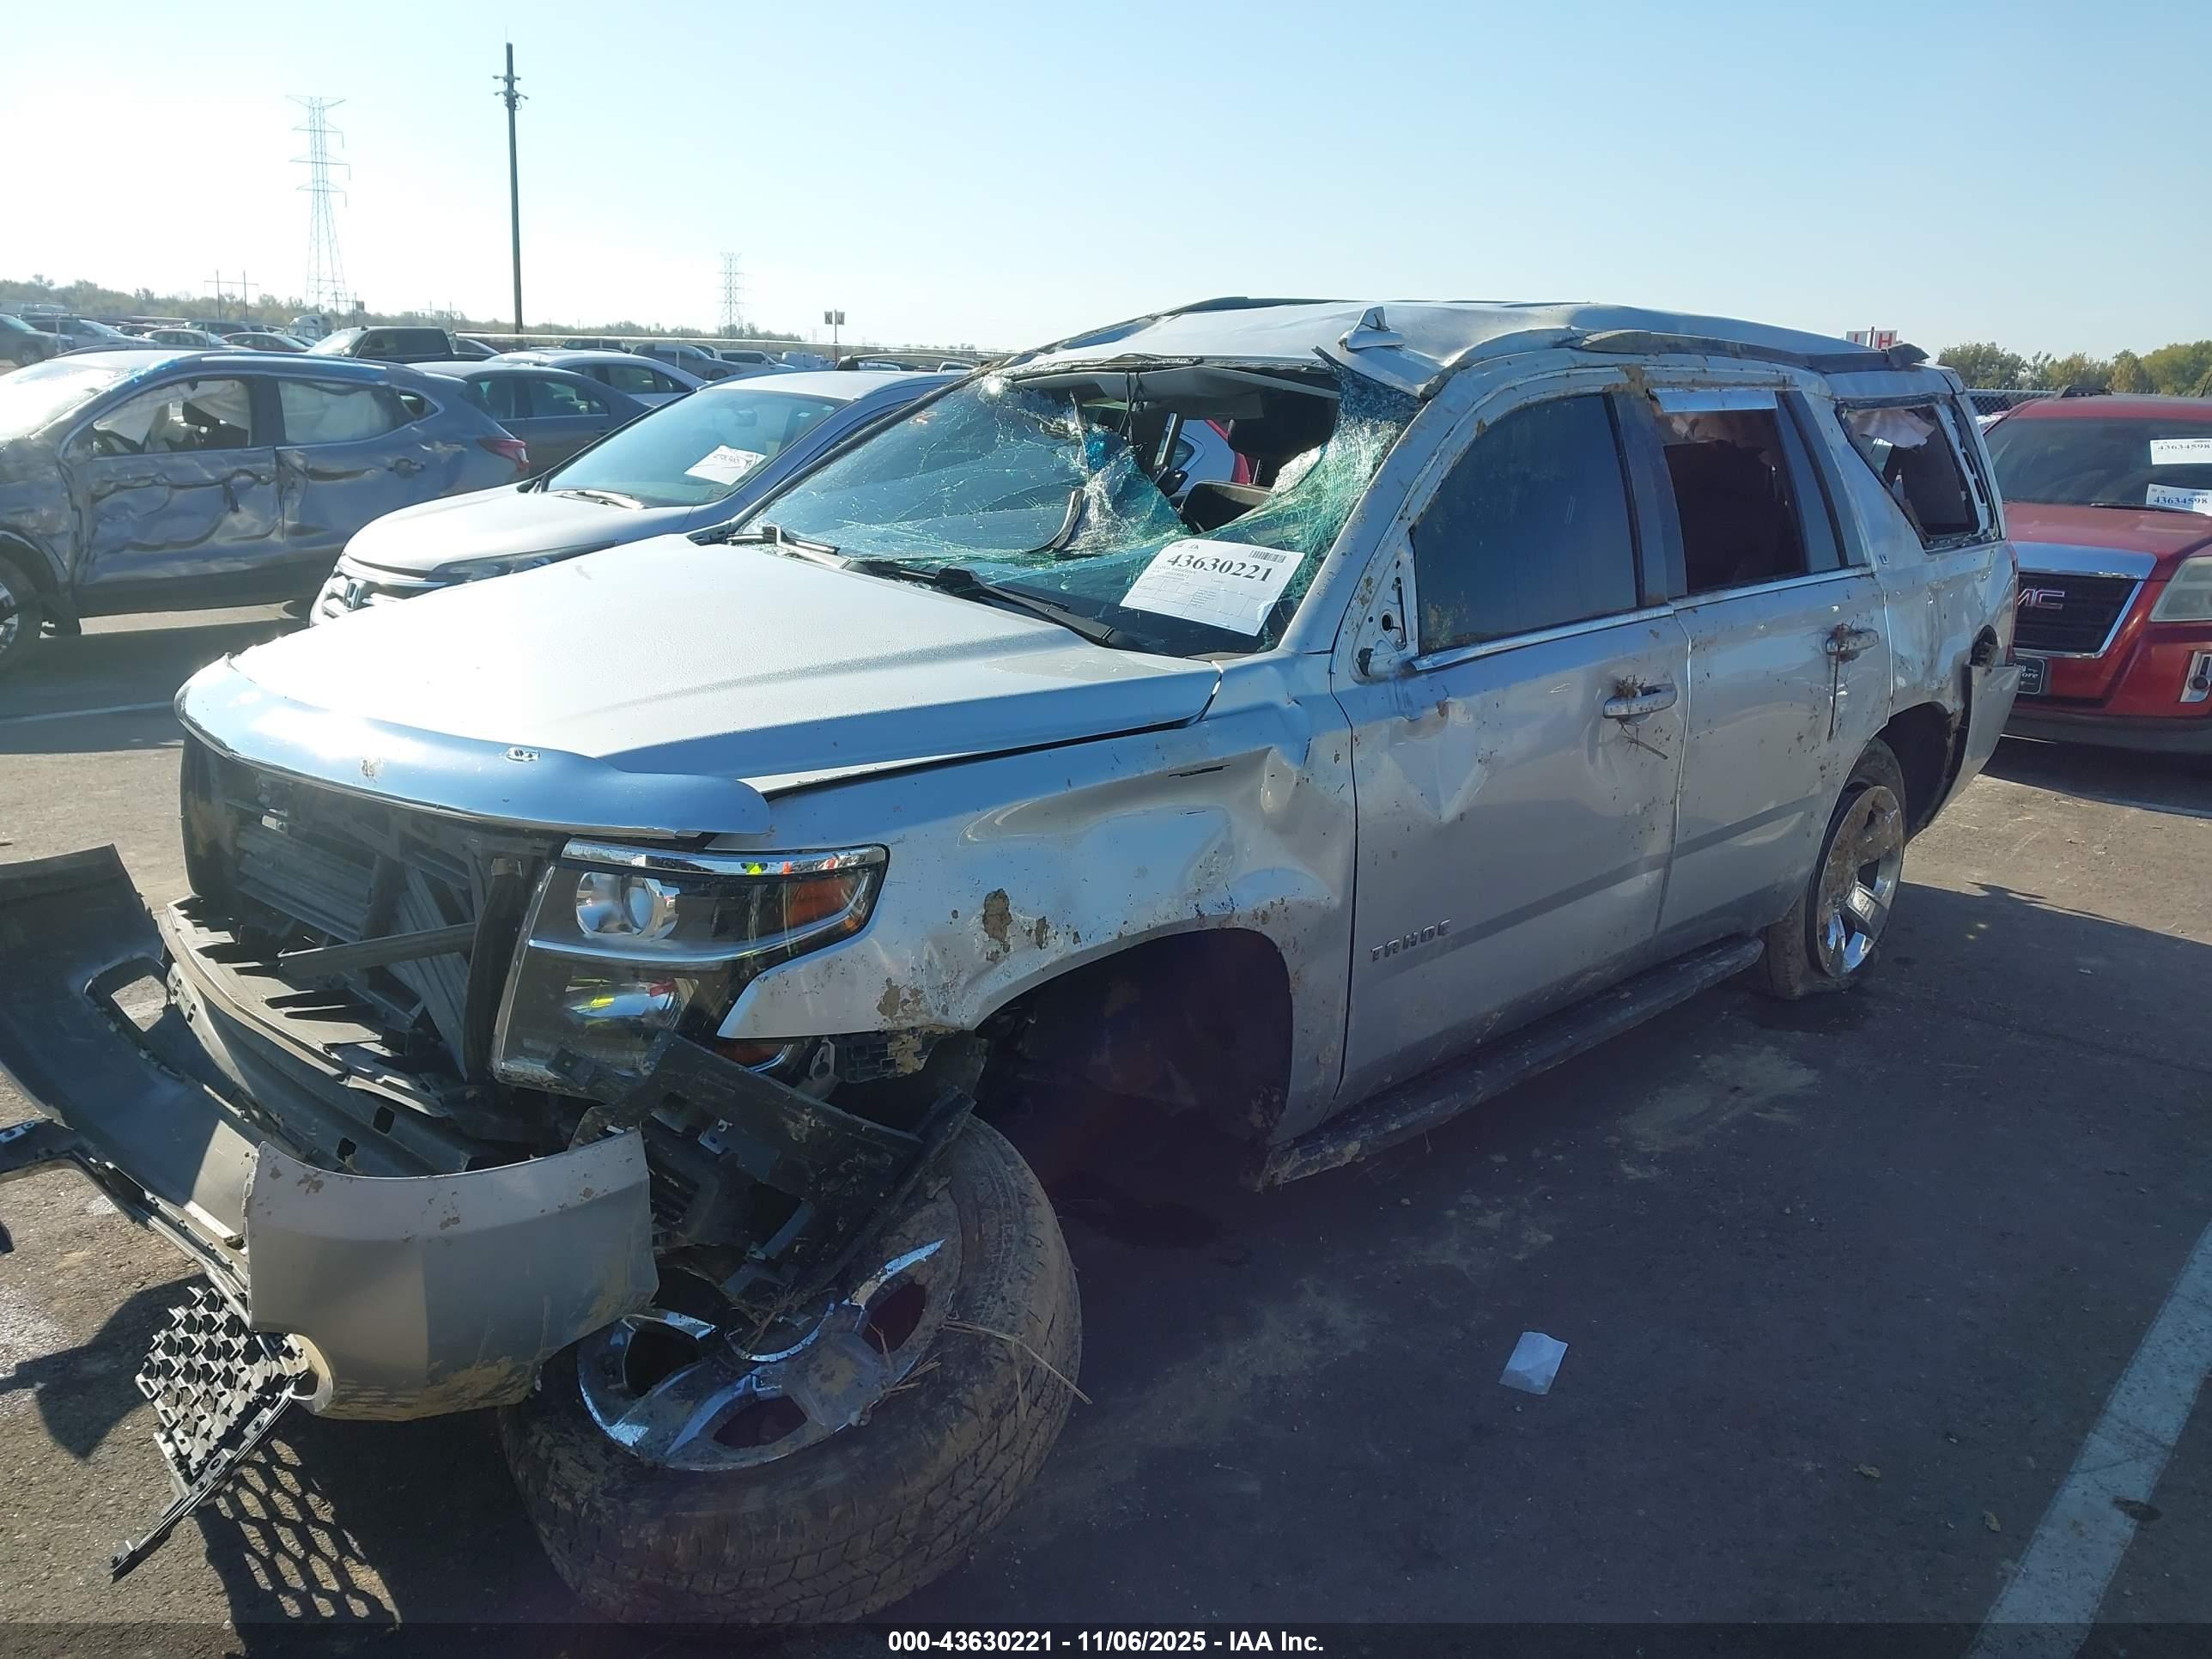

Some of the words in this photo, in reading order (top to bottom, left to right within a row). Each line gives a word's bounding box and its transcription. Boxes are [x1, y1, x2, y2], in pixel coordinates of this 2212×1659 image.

[1877, 332, 1893, 349] H
[2153, 495, 2209, 505] 43634598
[1166, 553, 1274, 582] 43630221
[2017, 588, 2065, 610] MC
